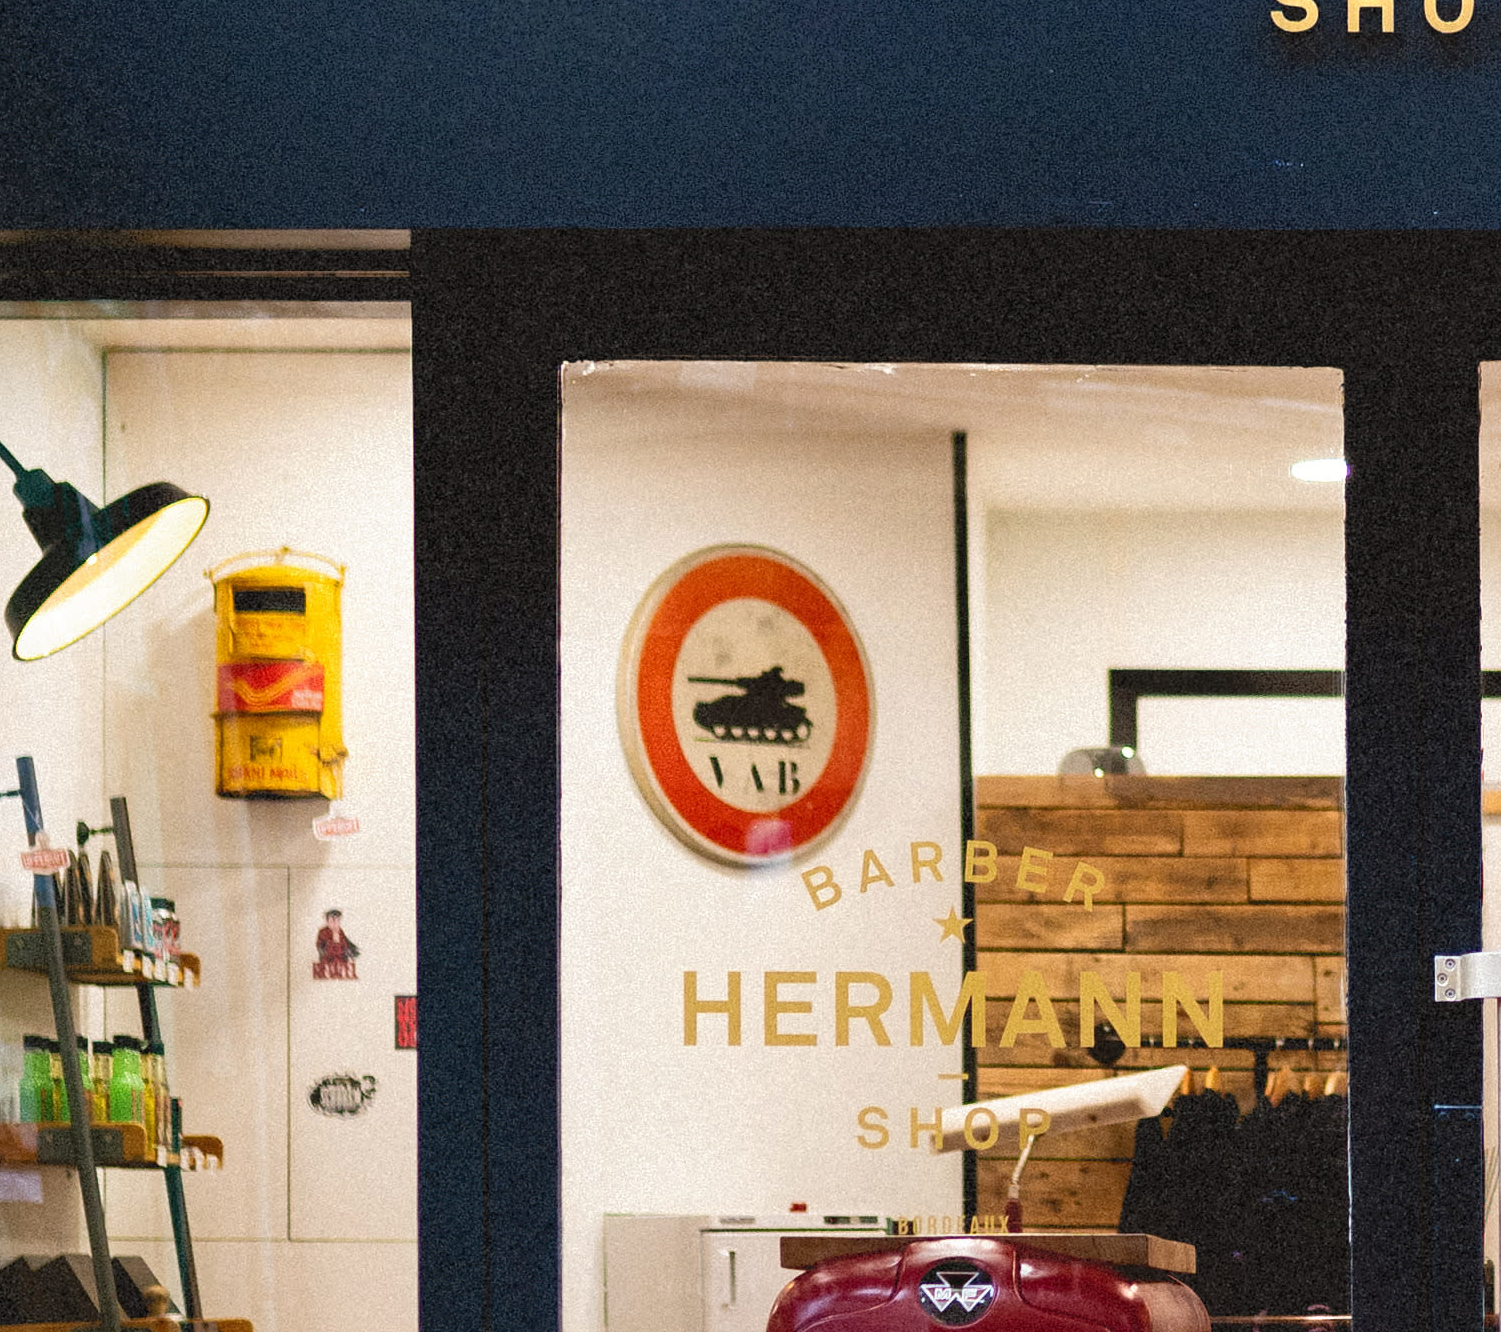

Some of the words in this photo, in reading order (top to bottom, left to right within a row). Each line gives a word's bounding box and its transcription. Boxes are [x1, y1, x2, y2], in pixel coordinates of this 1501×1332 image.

[801, 840, 1106, 911] BARBER
[683, 970, 1225, 1049] HERMANN
[856, 1105, 1052, 1150] SHOP
